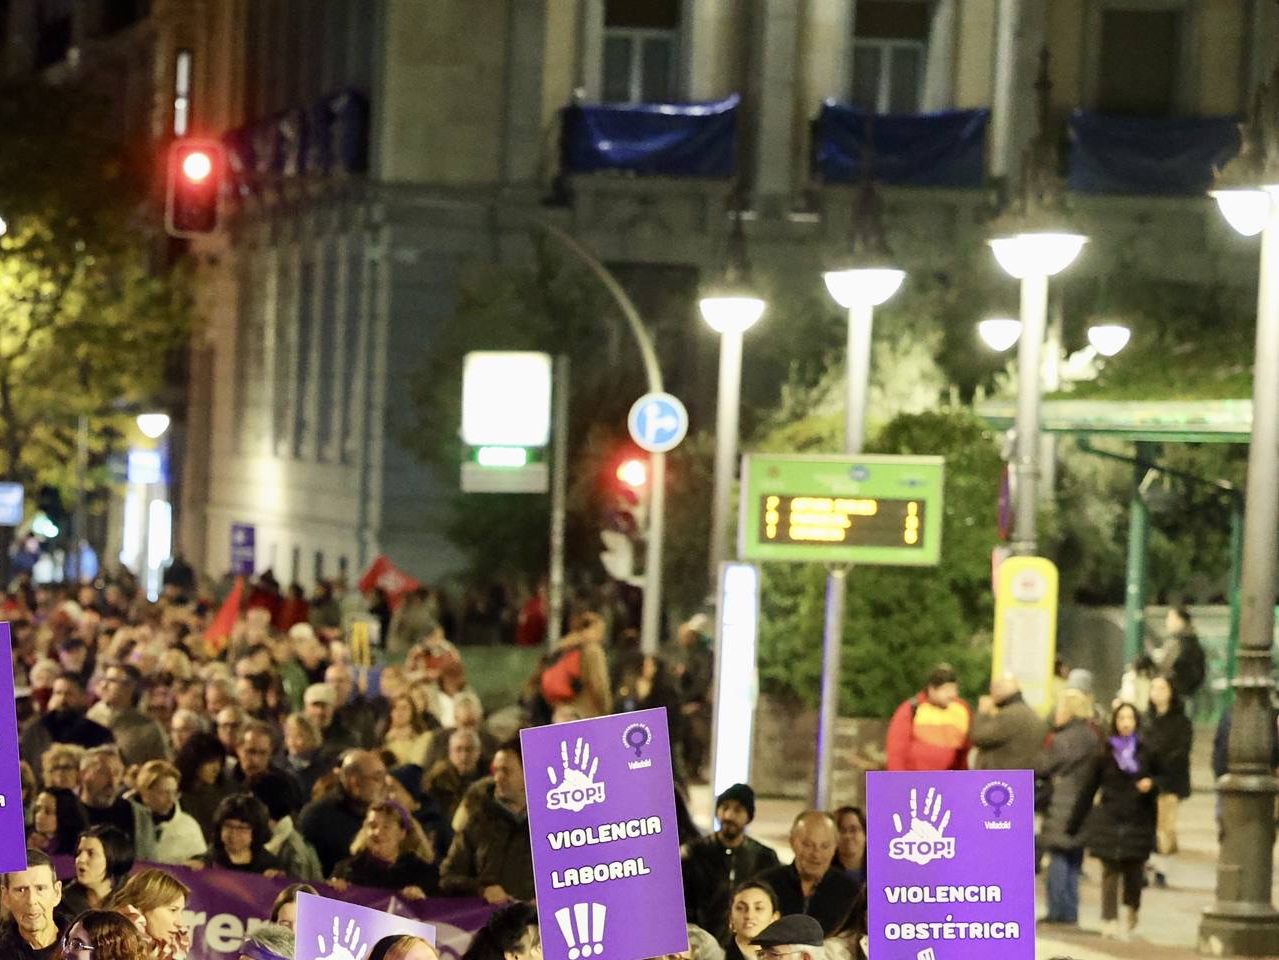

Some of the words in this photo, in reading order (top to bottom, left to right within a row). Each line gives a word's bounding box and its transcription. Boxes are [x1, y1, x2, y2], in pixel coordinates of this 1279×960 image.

[550, 786, 602, 806] STOP!
[547, 816, 662, 850] VIOLENCIA
[892, 841, 952, 856] STOP!
[550, 857, 651, 889] LABORAL
[884, 885, 1001, 903] VIOLENCIA
[884, 914, 1020, 940] OBSTÉTRICA
